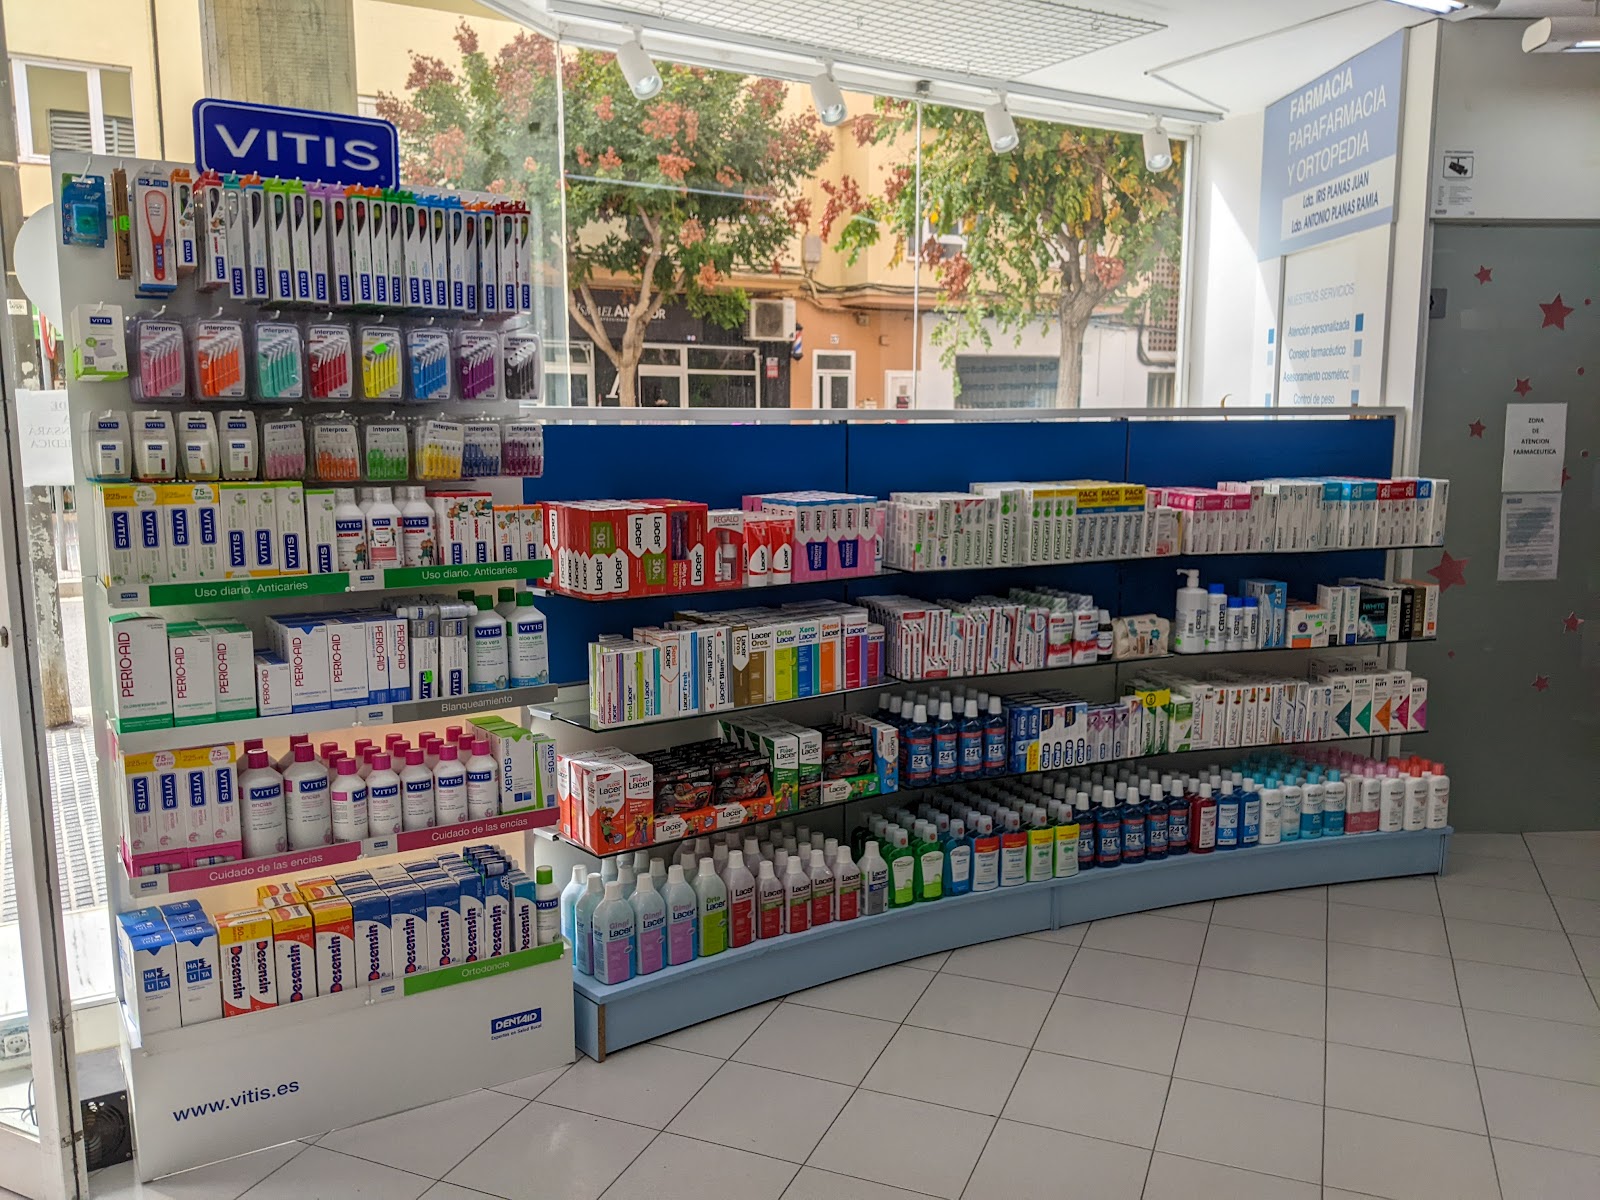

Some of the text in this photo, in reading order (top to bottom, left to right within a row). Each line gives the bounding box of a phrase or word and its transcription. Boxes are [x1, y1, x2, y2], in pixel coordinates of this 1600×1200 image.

[1290, 67, 1353, 122] FARMACIA
[1289, 85, 1386, 154] PARAFARMACIA
[215, 124, 378, 171] VITIS
[1287, 130, 1369, 187] Y ORTOPEDIA
[1316, 188, 1326, 204] IRIS
[1327, 178, 1350, 200] PLANAS
[1352, 171, 1369, 190] JUAN
[1304, 208, 1330, 229] ANTONIO
[1331, 199, 1355, 220] PLANAS
[1356, 191, 1378, 212] RAMIA
[1287, 283, 1355, 306] NUESTROS SERVICIOS
[1288, 319, 1349, 337] Atención personalizada
[1289, 344, 1346, 361] Consejo farmacéutico
[1283, 369, 1321, 382] Asesoramiento
[1293, 393, 1335, 405] Control de peso
[337, 521, 361, 529] VITIS
[422, 566, 518, 579] Uso diario. Anticaries
[195, 581, 309, 598] Uso diario. Anticaries
[476, 627, 501, 636] VITIS
[519, 623, 543, 631] VITIS
[441, 695, 513, 712] Blanqueamiento
[1193, 694, 1202, 740] DENTIBLANC
[439, 777, 463, 785] VITIS
[504, 757, 513, 793] xeros
[302, 780, 327, 789] VITIS
[374, 787, 398, 795] VITIS
[409, 781, 431, 790] VITIS
[599, 786, 622, 795] Lacer
[629, 780, 651, 789] Lacer
[253, 787, 280, 797] VITIS
[431, 818, 528, 841] Cuidado de las encías
[663, 823, 682, 832] Lacer
[209, 854, 323, 881] Cuidado de las encías
[815, 877, 834, 885] Lacer
[842, 873, 860, 881] Lacer
[735, 886, 754, 896] Lacer
[764, 888, 782, 897] Lacer
[792, 884, 810, 893] Lacer
[673, 902, 691, 911] Gingi
[706, 900, 726, 911] Lacer
[643, 909, 662, 920] Gingi
[673, 908, 695, 920] Lacer
[610, 920, 629, 929] Gingi
[643, 916, 665, 928] Lacer
[440, 910, 451, 966] Desensin
[465, 907, 477, 963] Desensin
[609, 925, 633, 938] Lacer
[369, 924, 380, 981] Desensin
[405, 918, 416, 974] Desensin
[187, 962, 198, 970] HA
[256, 940, 268, 995] Desensin
[330, 935, 342, 993] Desensin
[461, 961, 510, 977] Ortodoncia
[145, 971, 155, 979] HA
[230, 946, 246, 1000] Desensin
[290, 944, 303, 1002] Desensin
[496, 1013, 537, 1030] DENTAID
[173, 1080, 300, 1123] www.vitis.es
